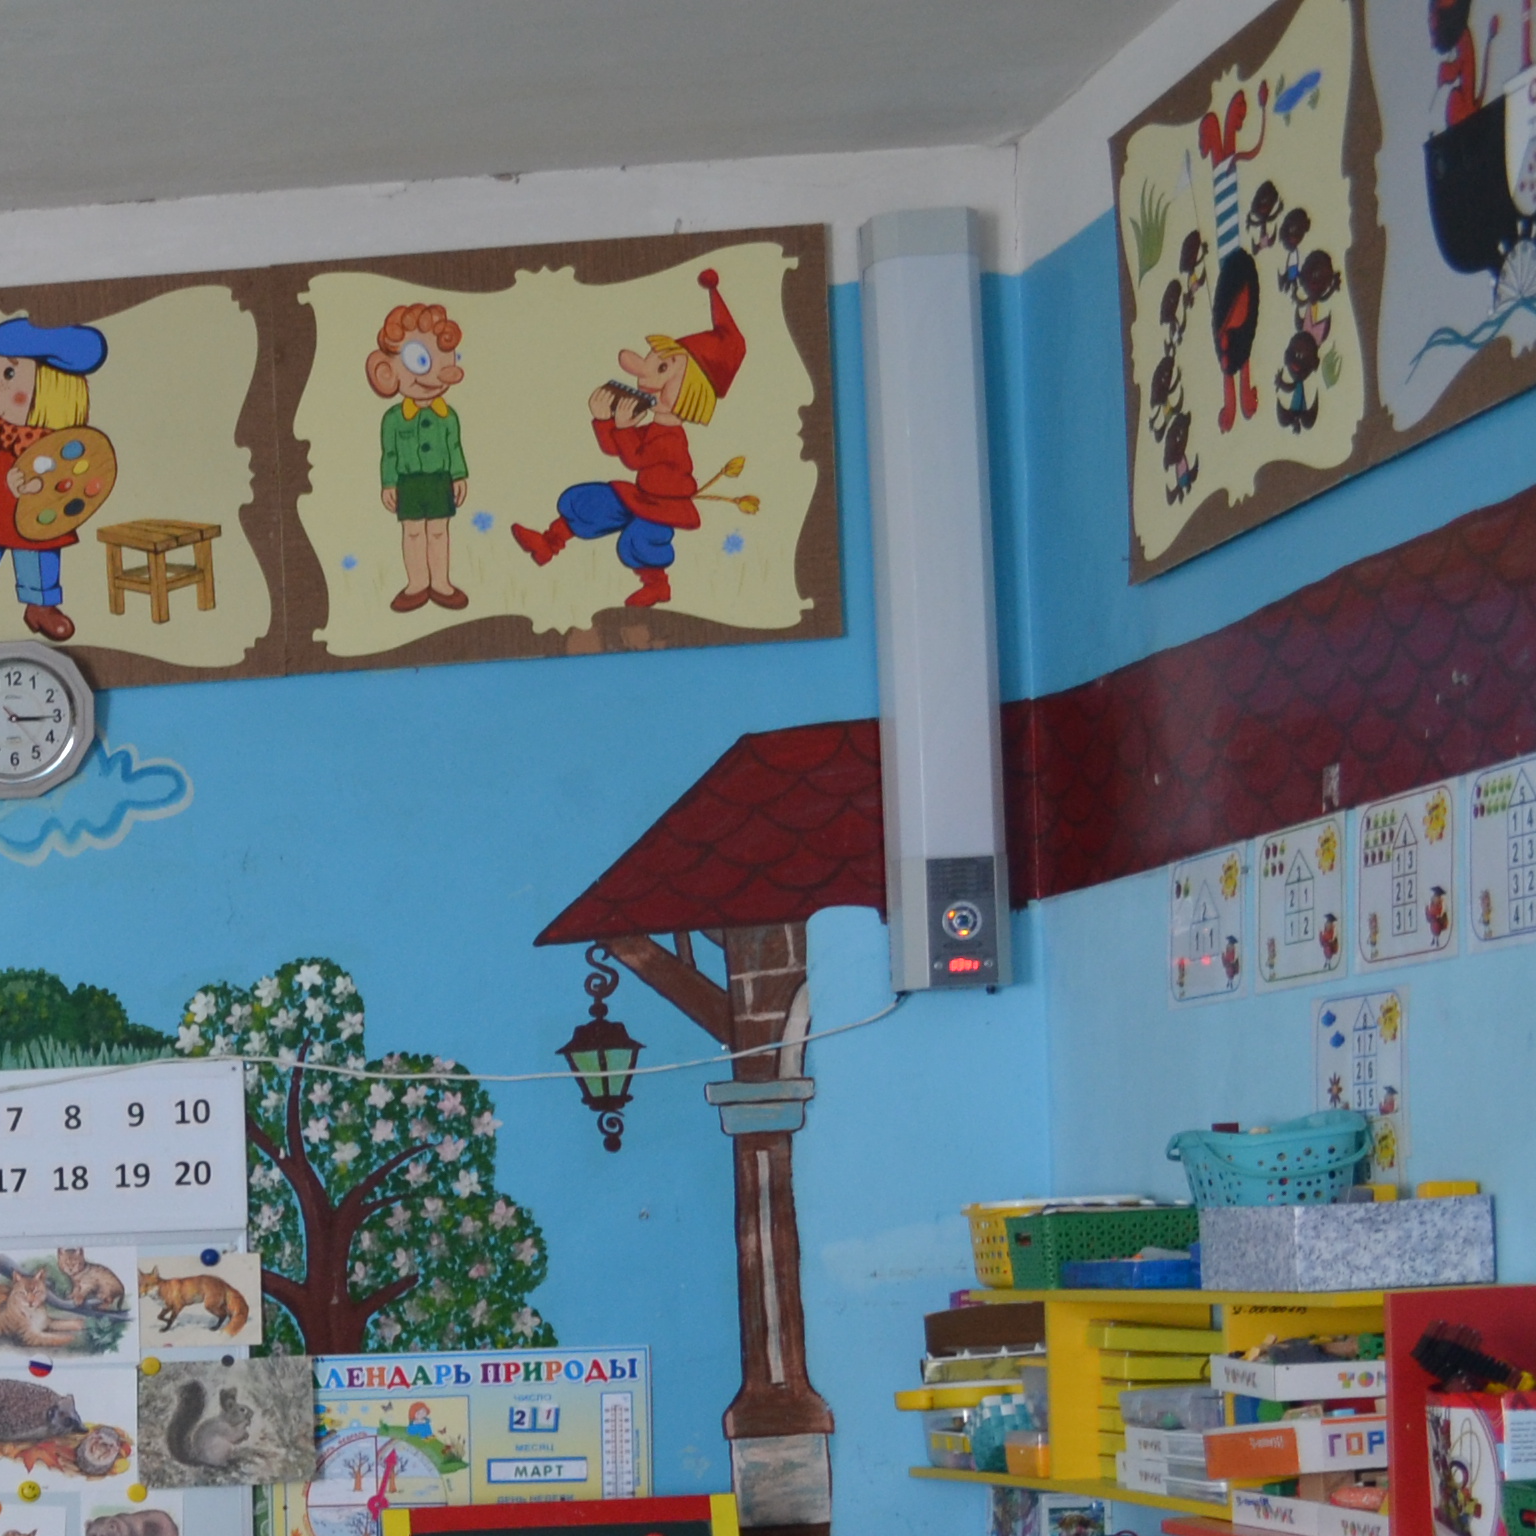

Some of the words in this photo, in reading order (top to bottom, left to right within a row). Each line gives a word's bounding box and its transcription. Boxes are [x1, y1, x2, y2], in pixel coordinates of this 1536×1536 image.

[5, 671, 22, 687] 12
[29, 676, 37, 690] 1
[46, 689, 55, 703] 2
[53, 709, 62, 723] 3
[46, 730, 55, 744] 4
[10, 752, 20, 766] 6
[32, 745, 41, 759] 5
[6, 1107, 23, 1132] 7
[64, 1105, 82, 1130] 8
[127, 1102, 145, 1127] 9
[175, 1099, 211, 1125] 10
[54, 1165, 89, 1191] 18
[115, 1163, 150, 1188] 19
[175, 1160, 211, 1186] 20
[480, 1357, 638, 1385] ПРИРОДЫ
[513, 1409, 526, 1426] 2
[515, 1443, 555, 1453] МЕСЯЦ
[513, 1465, 565, 1479] МАРТ
